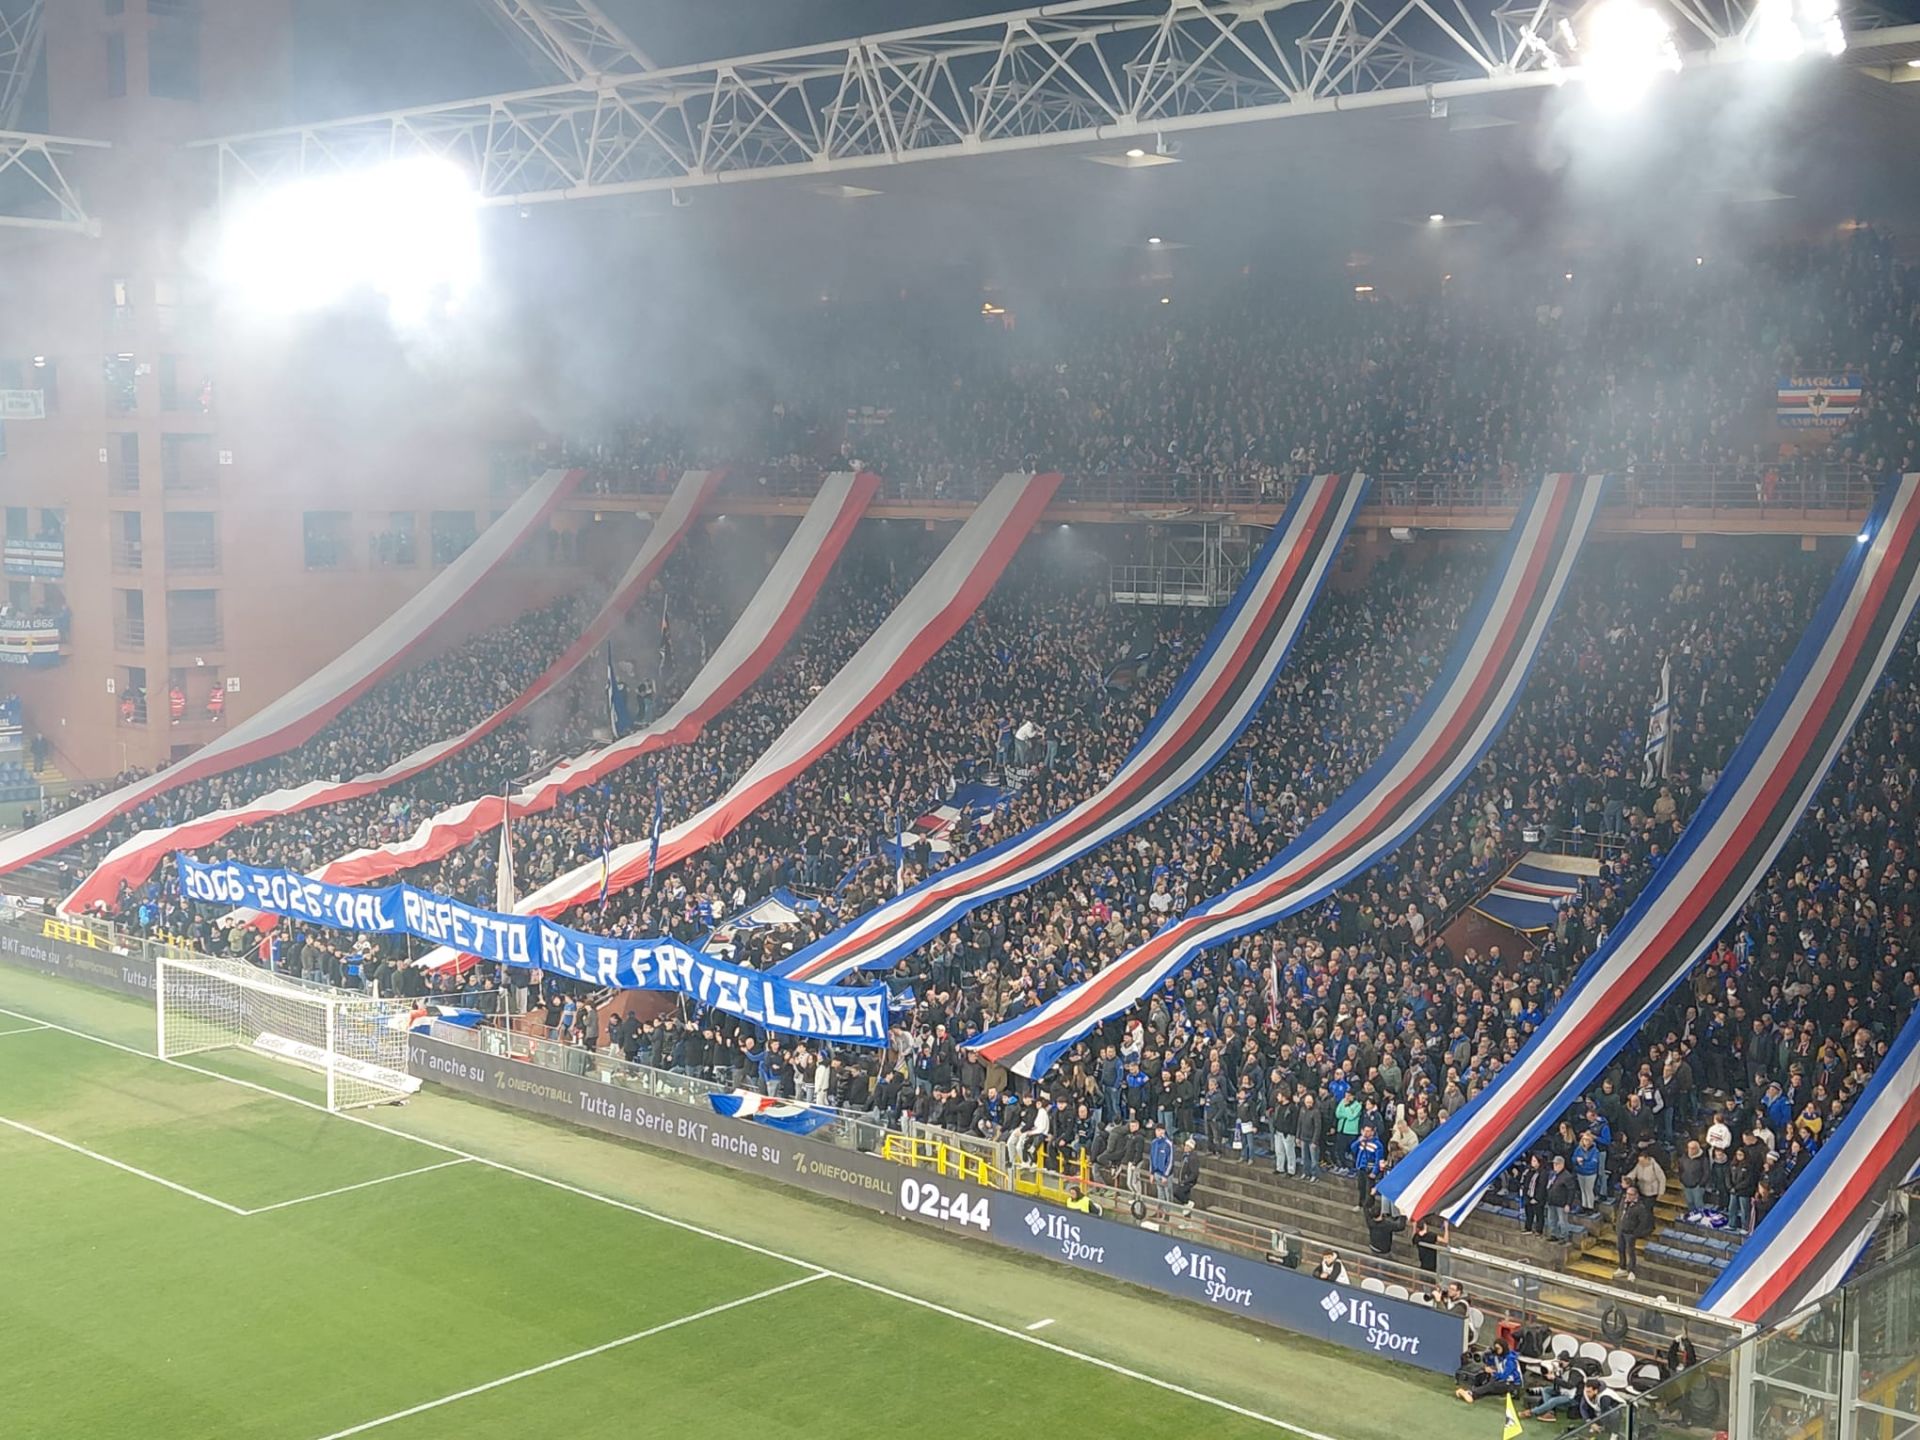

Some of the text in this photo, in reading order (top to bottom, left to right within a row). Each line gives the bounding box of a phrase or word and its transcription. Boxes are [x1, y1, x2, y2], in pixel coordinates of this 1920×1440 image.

[1790, 376, 1849, 387] MAGICA
[1, 936, 19, 951] BKT
[20, 945, 46, 961] anche
[122, 967, 148, 987] Tutta
[403, 890, 530, 962] RISPETTO
[540, 925, 625, 986] ALLA
[630, 945, 885, 1038] FRATELLANZA
[429, 1055, 467, 1078] anche
[469, 1067, 485, 1082] su
[507, 1077, 572, 1104] ONEFOOTBALL
[579, 1091, 616, 1118] Tutta
[619, 1103, 632, 1122] la
[635, 1107, 673, 1134] Serie
[677, 1118, 708, 1143] BKT
[711, 1132, 757, 1157] anche
[761, 1147, 780, 1164] su
[810, 1160, 893, 1195] ONEFOOTBALL
[900, 1178, 990, 1231] 02:44
[1047, 1214, 1081, 1242] Ifis
[1061, 1238, 1105, 1263] sport
[1189, 1252, 1227, 1283] Ifis
[1204, 1279, 1252, 1306] sport
[1348, 1298, 1390, 1331] Ifis
[1366, 1327, 1420, 1355] sport
